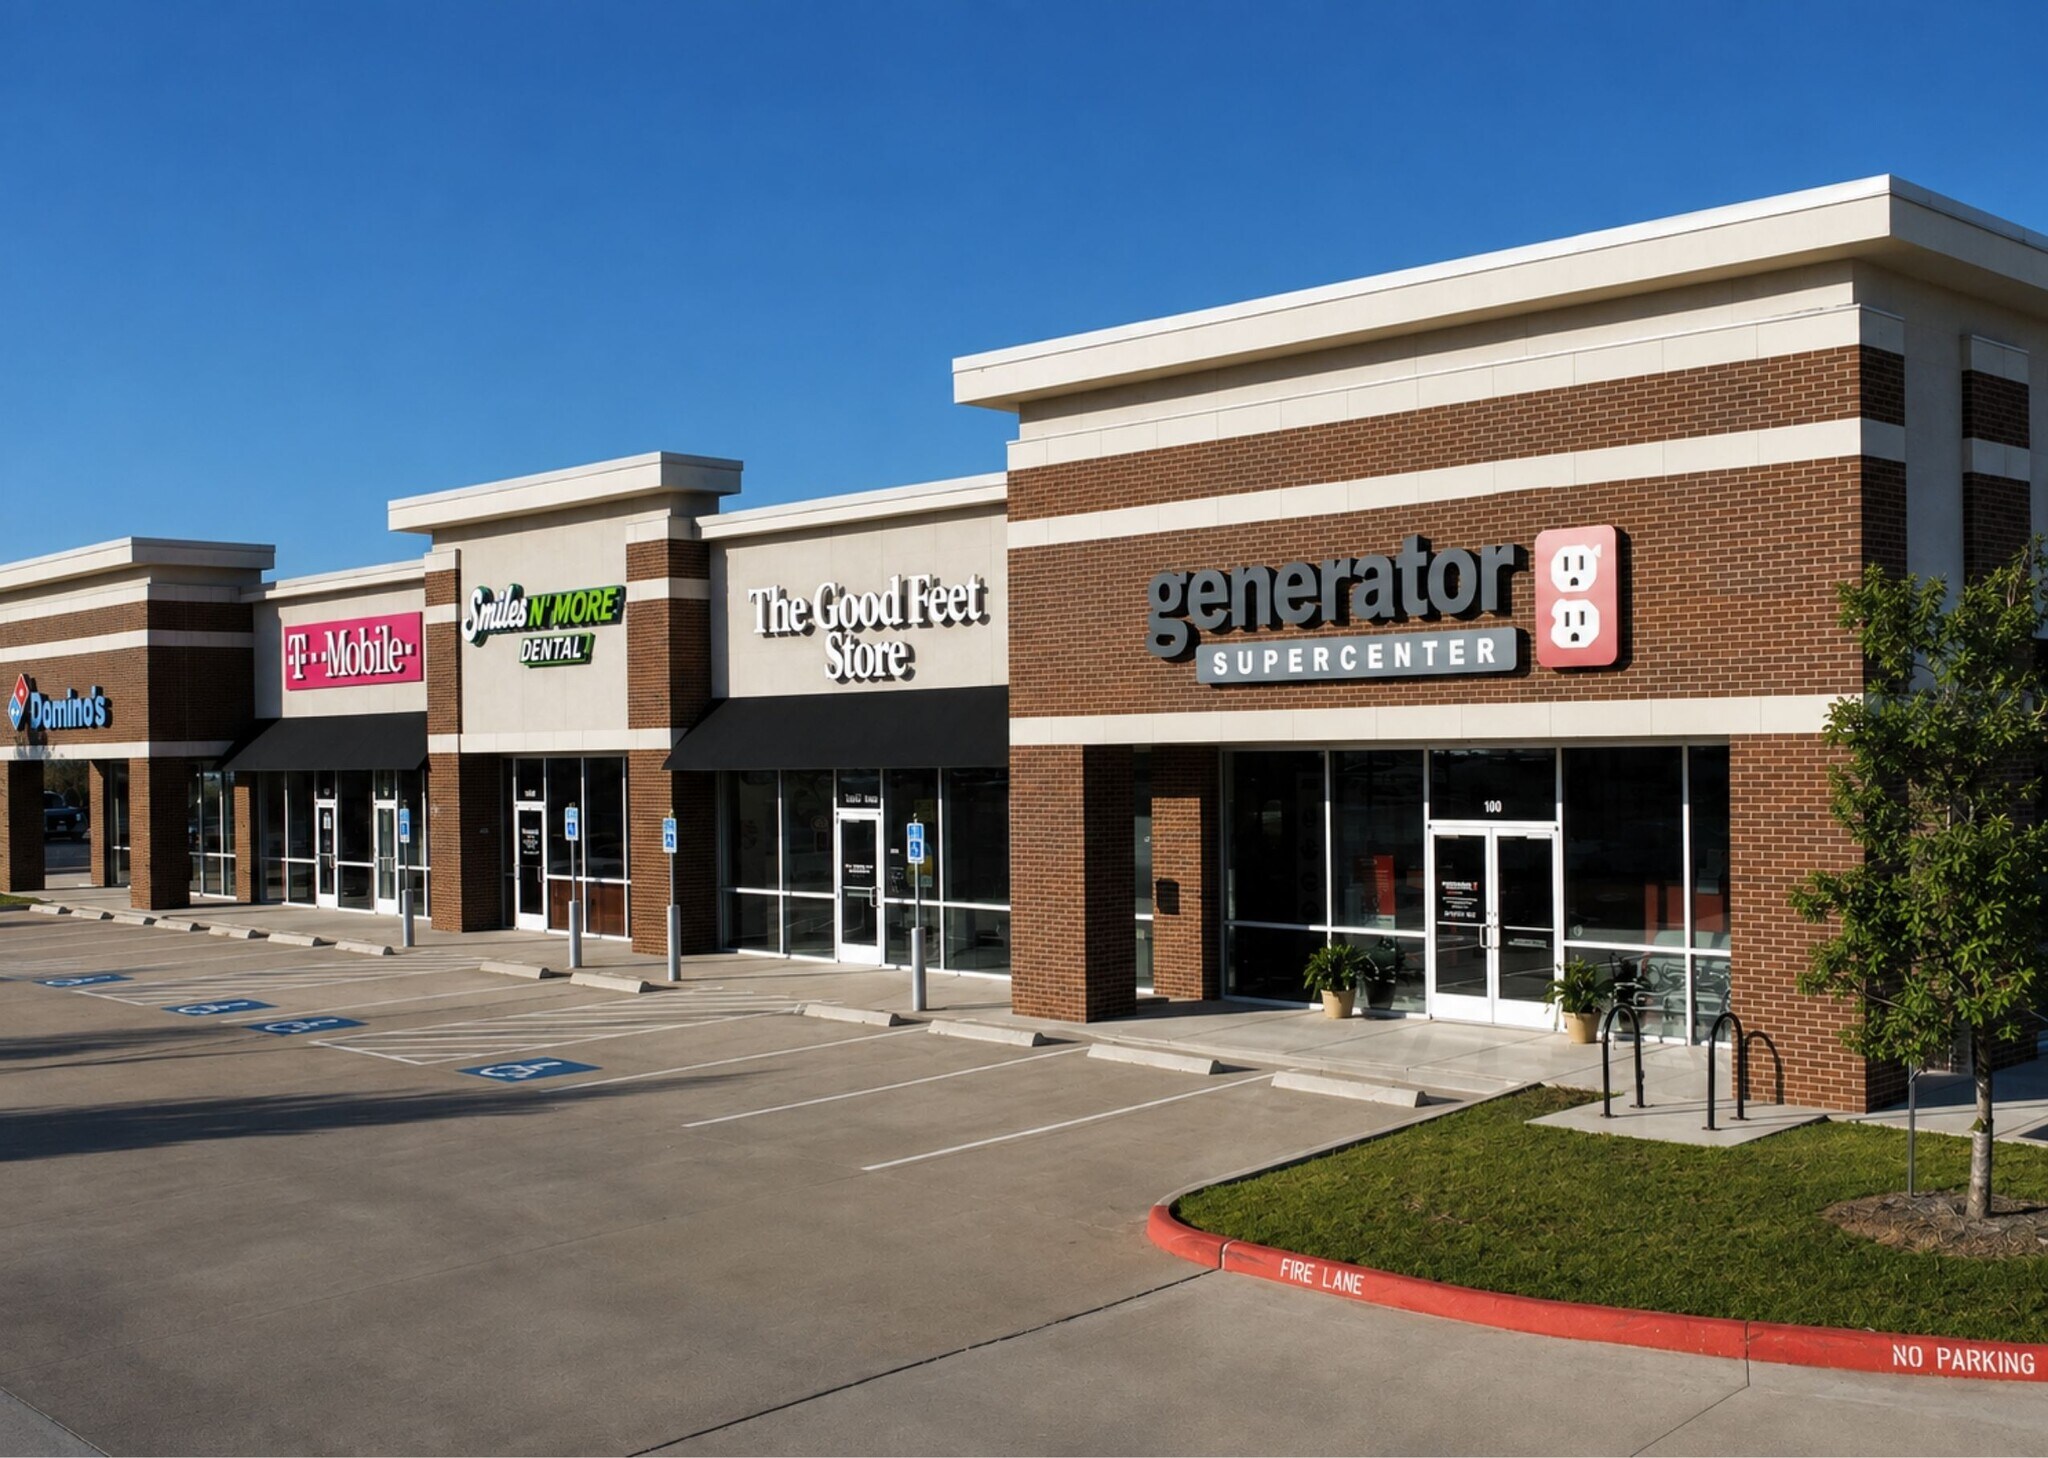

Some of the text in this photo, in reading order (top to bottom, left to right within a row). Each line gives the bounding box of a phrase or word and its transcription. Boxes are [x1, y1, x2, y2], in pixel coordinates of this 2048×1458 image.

[461, 585, 528, 643] Smiles
[552, 588, 616, 624] MORE
[748, 574, 982, 634] The Good Feet
[1146, 534, 1514, 658] generator
[520, 636, 581, 662] DENTAL
[824, 631, 908, 680] Store
[1213, 637, 1496, 676] SUPERCENTER
[30, 685, 106, 729] Domino's
[1484, 800, 1502, 813] 100
[1280, 1258, 1365, 1295] FIRE LANE
[1893, 1344, 2035, 1375] NO PARKING
